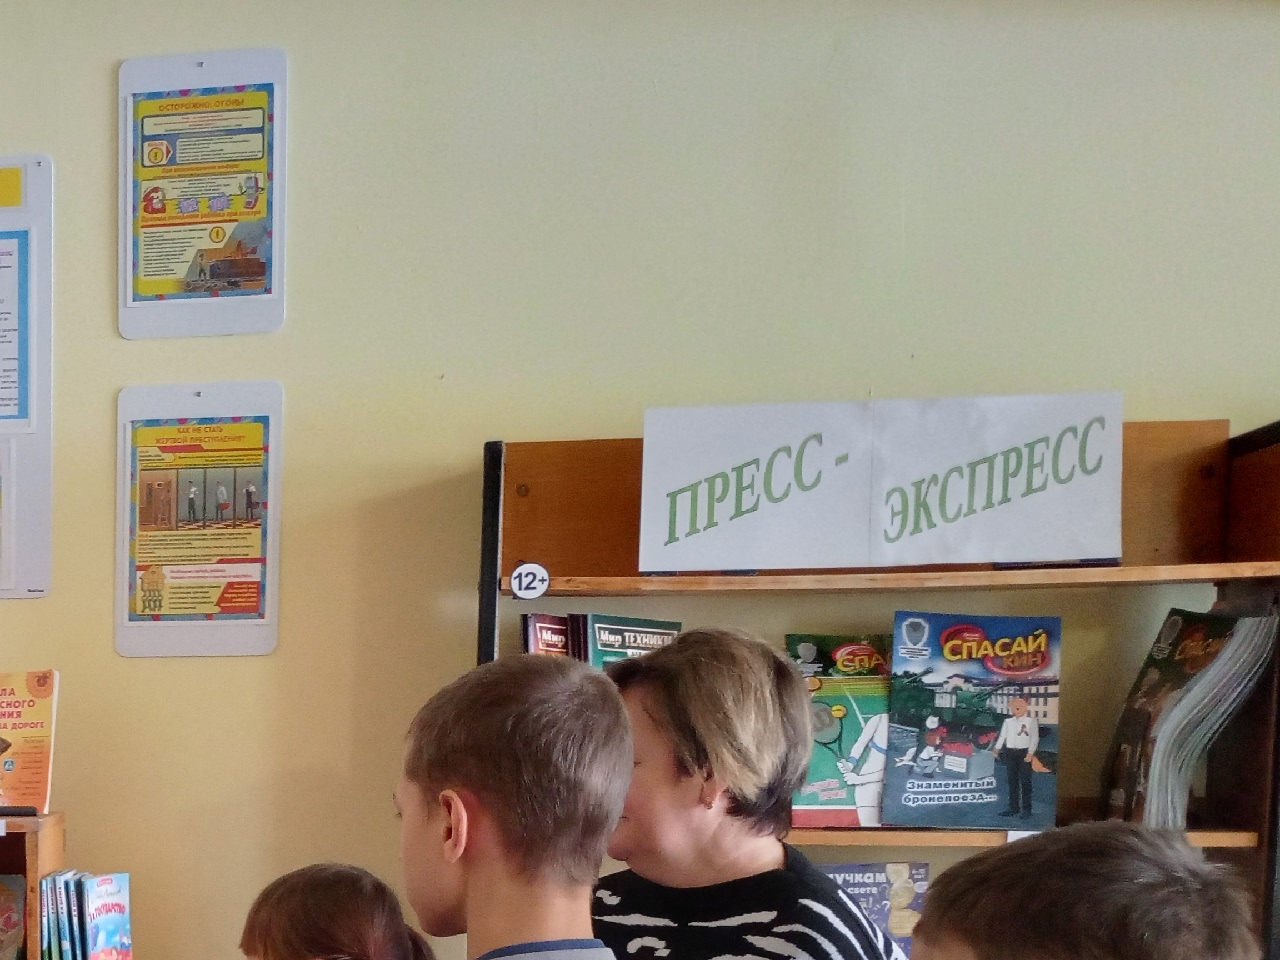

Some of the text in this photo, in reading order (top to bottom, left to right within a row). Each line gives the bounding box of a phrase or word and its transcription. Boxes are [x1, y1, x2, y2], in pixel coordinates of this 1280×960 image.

[883, 415, 1107, 545] ЭКСПРЕСС
[663, 432, 825, 548] ПРЕСС
[513, 571, 548, 592] 12+
[541, 629, 566, 647] Мир
[600, 630, 622, 648] Мир
[943, 628, 1048, 662] СПАСАЙ
[836, 653, 892, 672] СПА
[1002, 653, 1043, 671] КИН
[11, 722, 45, 730] ДОРОГЕ
[906, 778, 995, 791] Знаменитый
